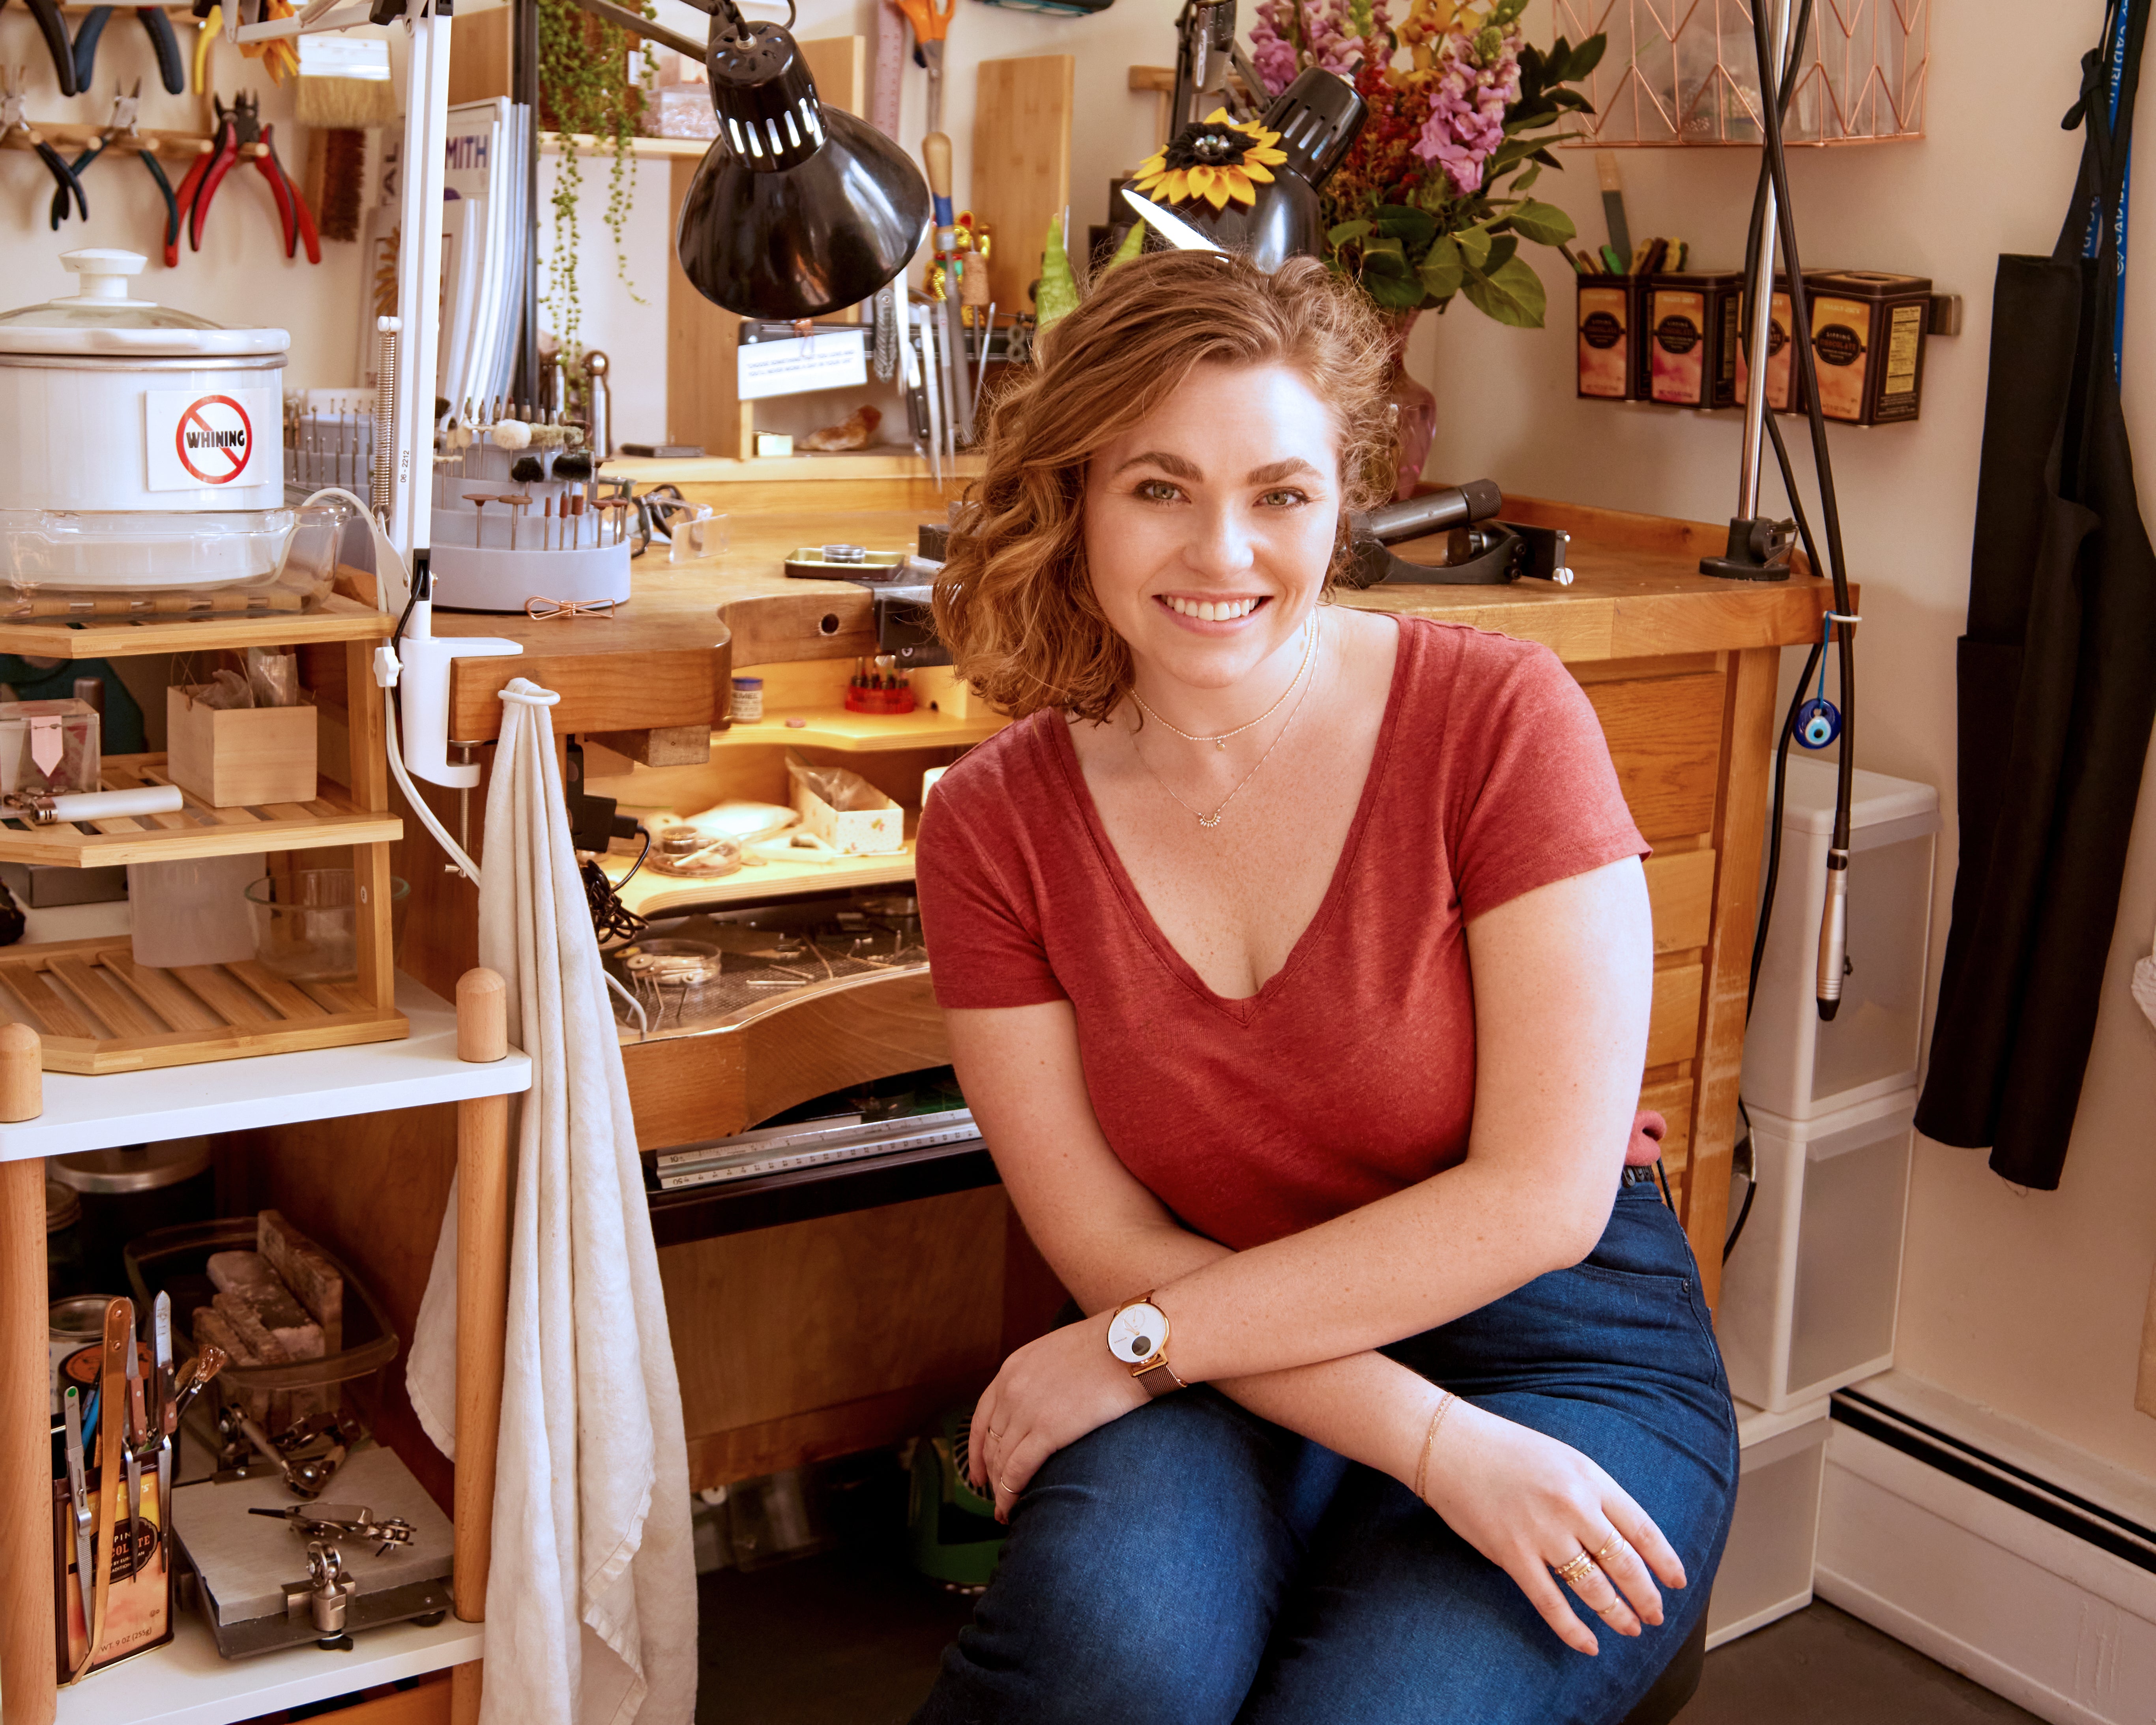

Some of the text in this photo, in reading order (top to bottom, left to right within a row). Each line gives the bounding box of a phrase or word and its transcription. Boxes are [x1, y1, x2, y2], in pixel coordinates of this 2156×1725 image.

[445, 134, 488, 169] MITH
[186, 430, 245, 448] WHINING
[400, 474, 407, 483] 06
[112, 1562, 131, 1572] ADITION
[122, 1635, 130, 1644] OZ
[132, 1627, 152, 1641] (255g)
